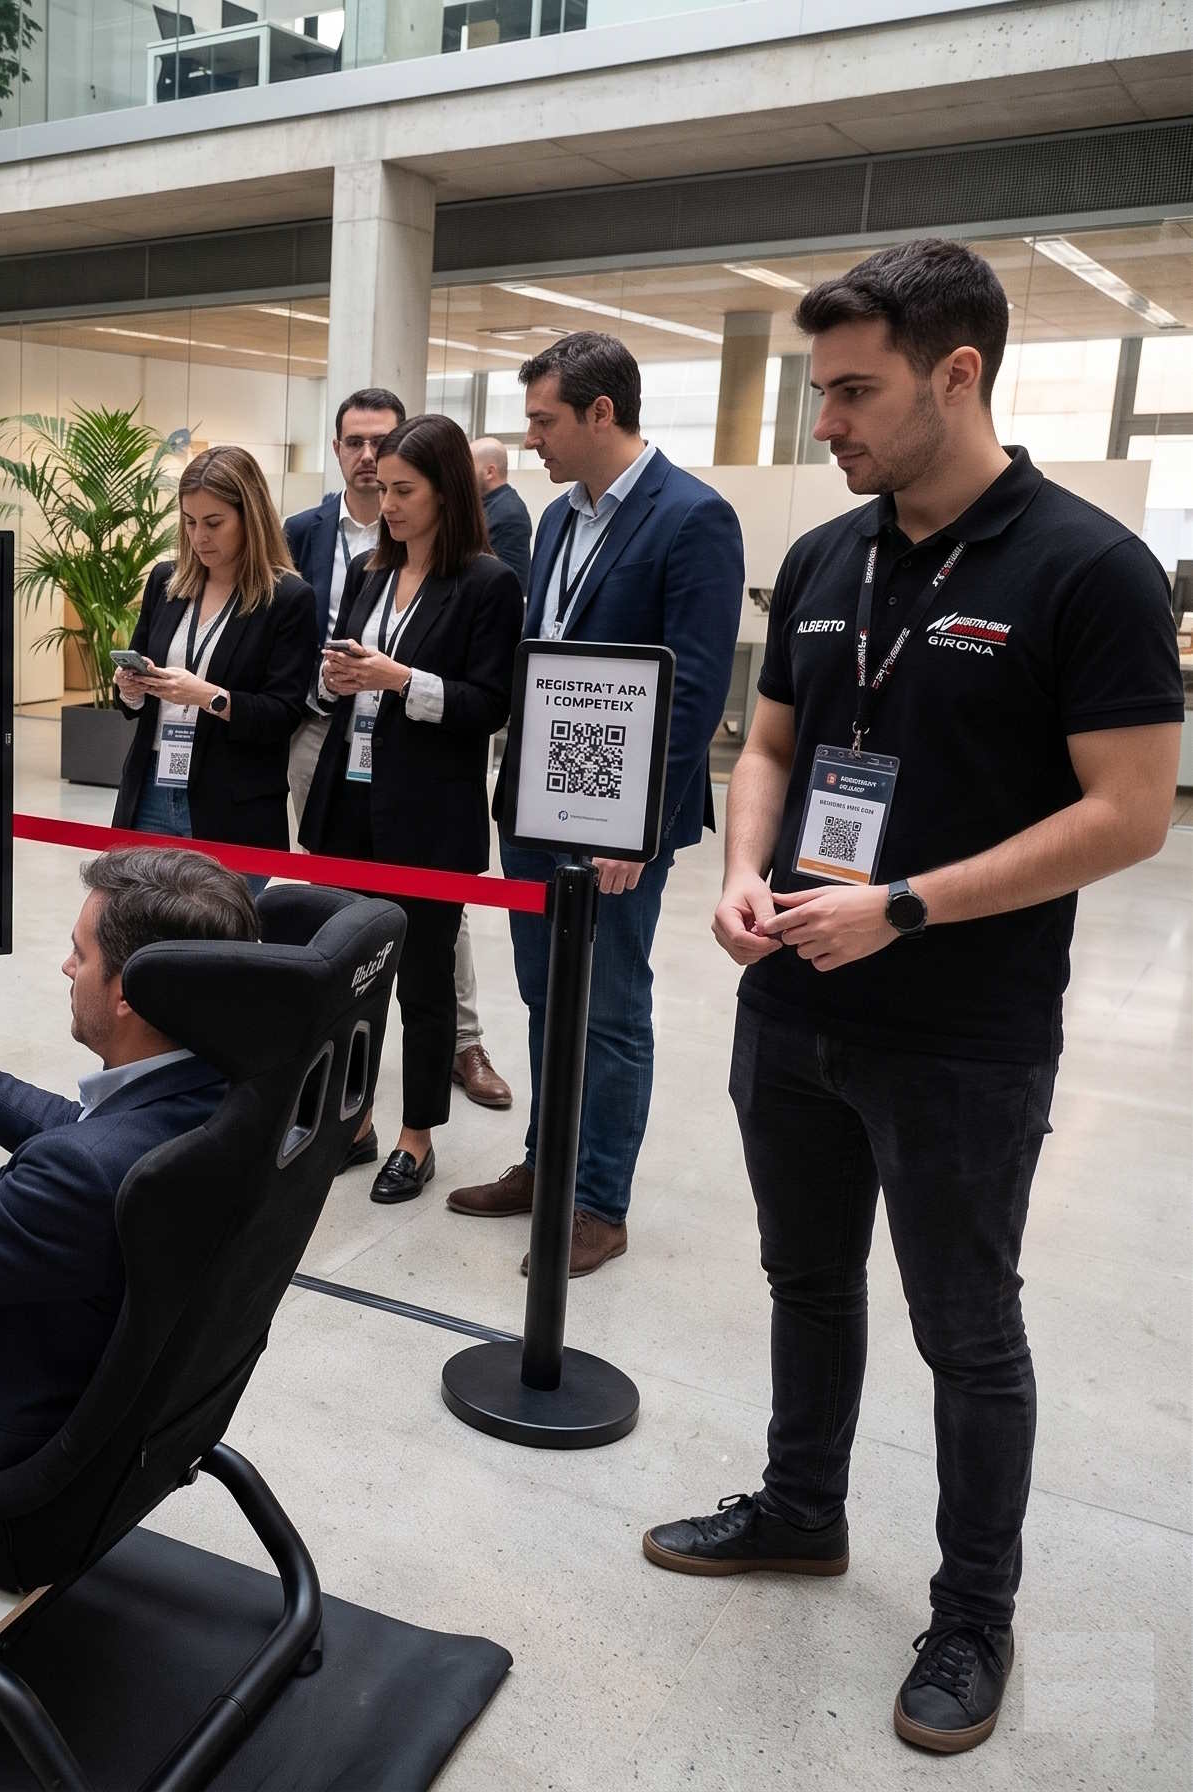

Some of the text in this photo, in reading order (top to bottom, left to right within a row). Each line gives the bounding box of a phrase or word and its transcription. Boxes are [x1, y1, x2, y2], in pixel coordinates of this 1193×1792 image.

[797, 620, 846, 634] ALBERTO
[928, 636, 994, 656] GIRONA
[536, 678, 647, 696] REGISTRA'T ARA
[545, 695, 634, 712] I COMPETEIX
